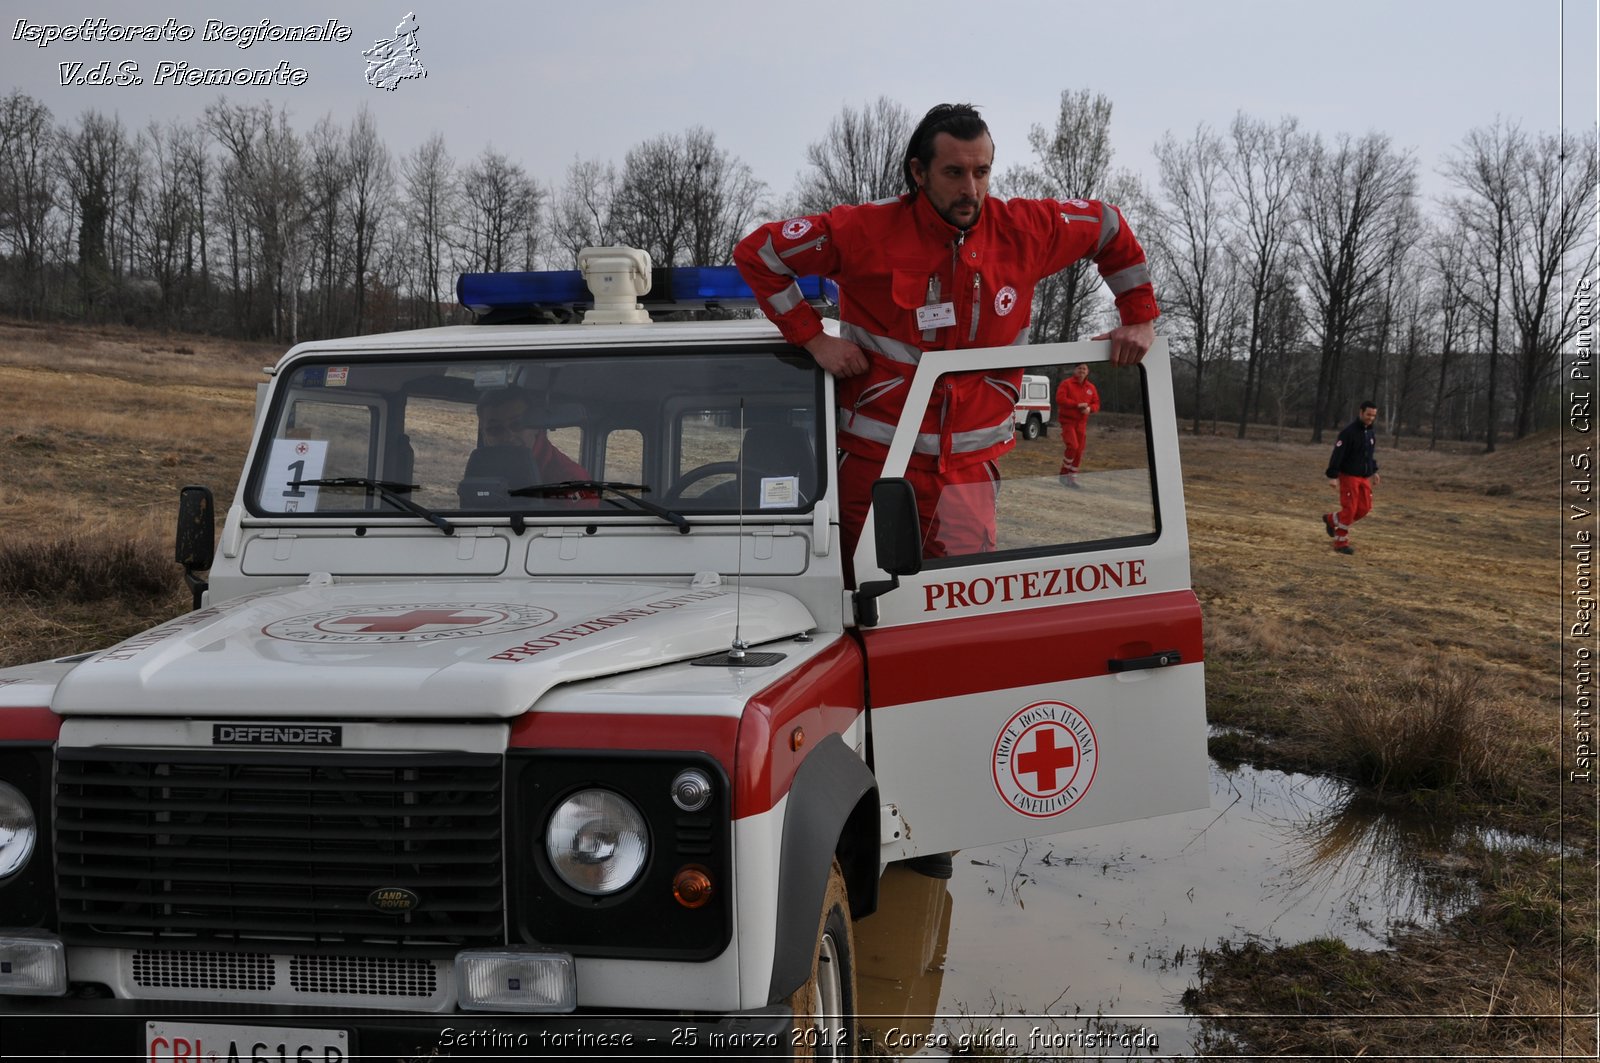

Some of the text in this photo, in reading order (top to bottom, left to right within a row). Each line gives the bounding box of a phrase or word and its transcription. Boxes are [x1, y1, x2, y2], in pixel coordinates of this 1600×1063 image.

[282, 460, 305, 497] 1
[923, 559, 1147, 612] PROTEZIONE
[488, 607, 659, 663] PROTEZIONE
[220, 727, 333, 743] DEFENDER
[997, 706, 1093, 764] CROCE ROSSA ITALIANA
[1013, 786, 1078, 813] CANELLI (AT)
[378, 891, 402, 900] LAND
[380, 900, 410, 908] ROVER
[150, 1036, 202, 1063] CRI
